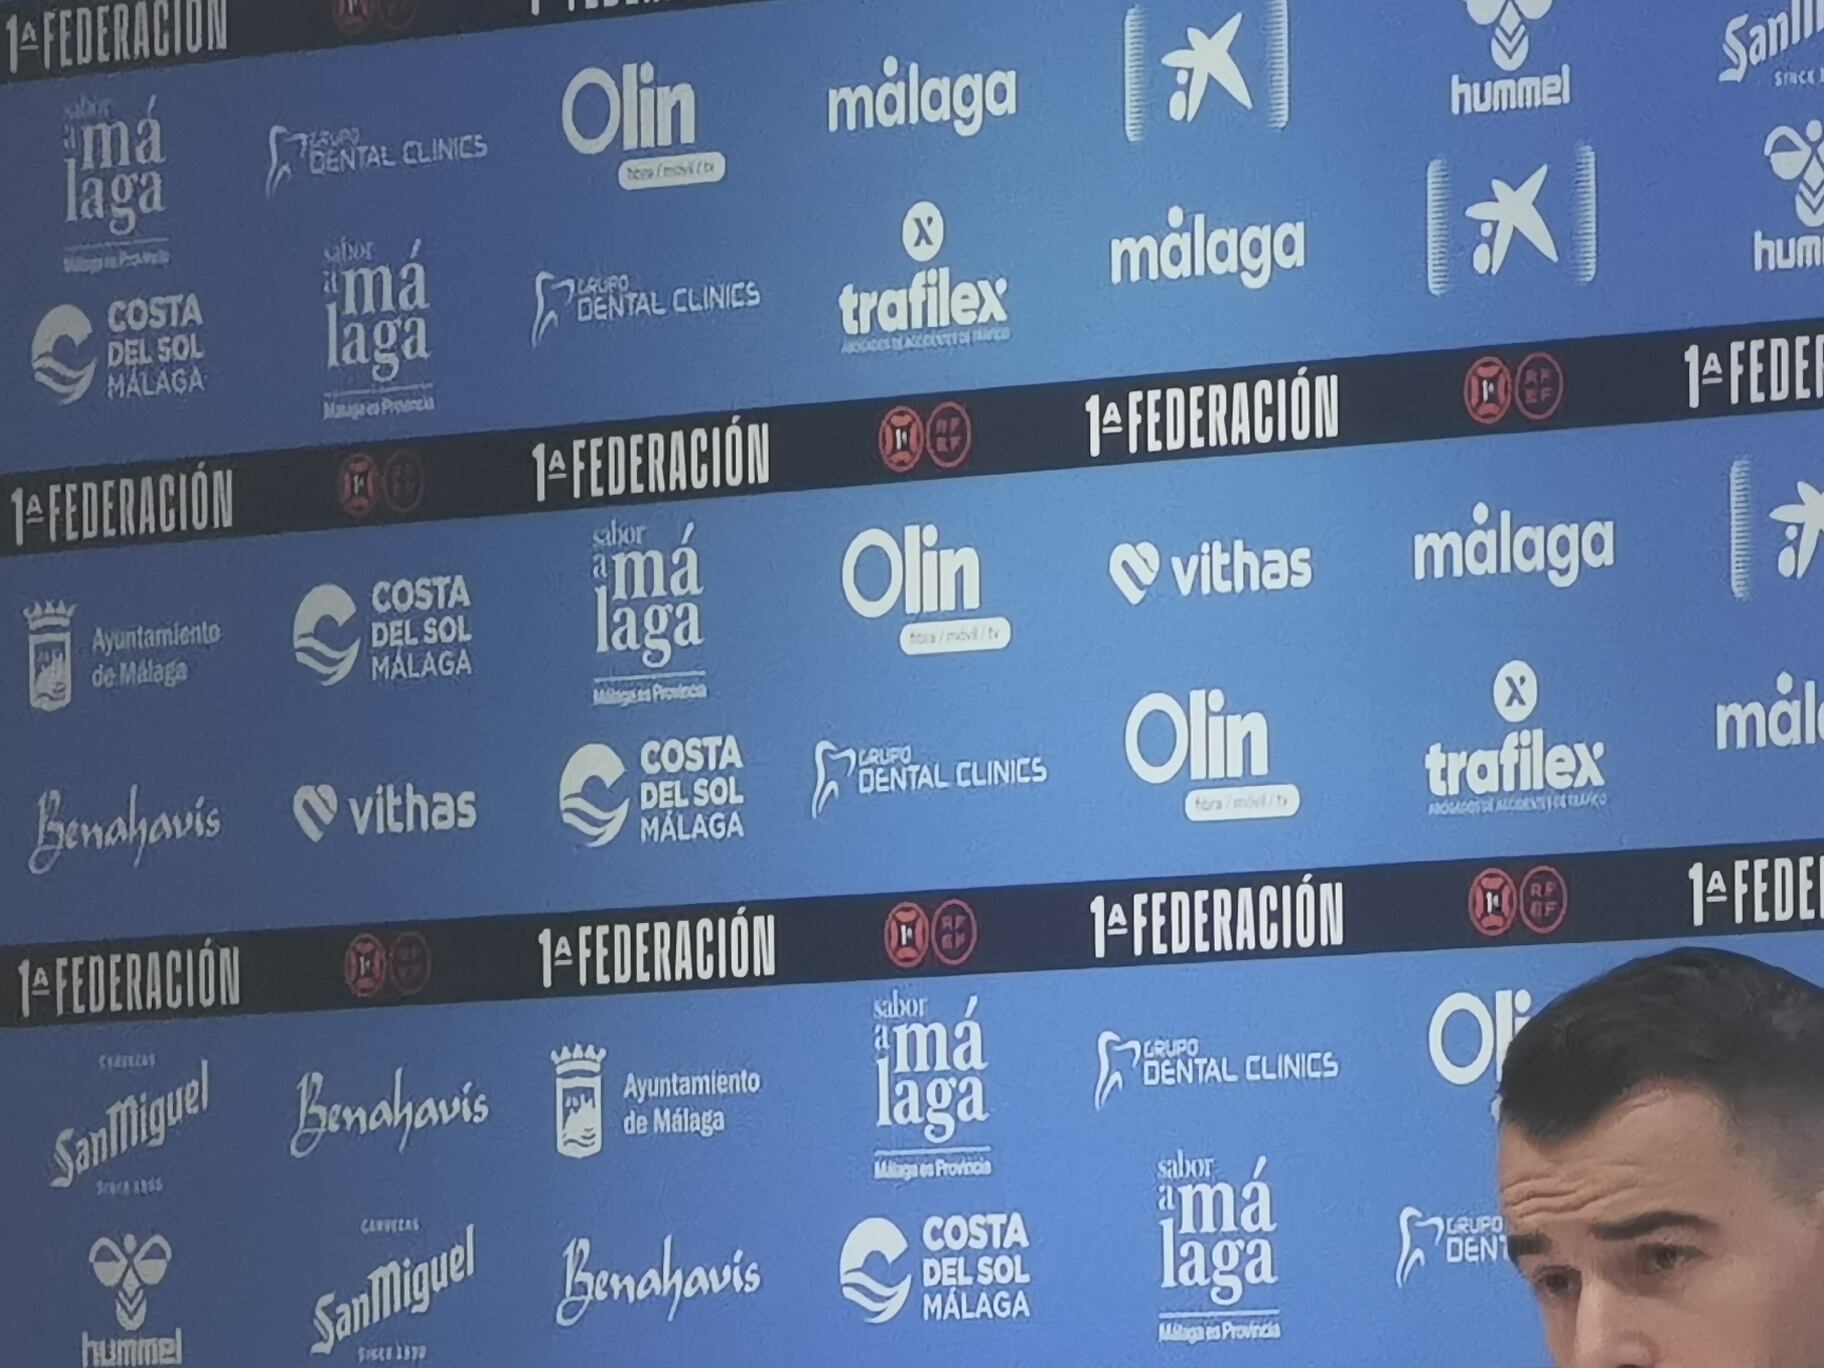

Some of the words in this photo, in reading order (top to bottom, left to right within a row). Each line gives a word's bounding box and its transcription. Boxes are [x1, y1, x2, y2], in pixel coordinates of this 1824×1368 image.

[562, 62, 695, 154] Olin
[1452, 64, 1570, 114] hummel
[342, 239, 429, 315] má
[839, 267, 1007, 336] trafilex
[108, 293, 203, 332] COSTA
[108, 338, 152, 370] DEL
[158, 333, 204, 362] SOL
[327, 306, 430, 382] laga
[108, 359, 204, 399] MÁLAGA
[1129, 367, 1338, 453] FEDERACIÓN
[573, 415, 769, 498] FEDERACIÓN
[50, 462, 232, 542] FEDERACIÓN
[612, 523, 703, 600] má
[843, 525, 979, 617] Olin
[1171, 540, 1311, 596] vithas
[372, 575, 470, 613] COSTA
[92, 621, 221, 656] Ayuntamiento
[372, 620, 417, 648] DEL
[424, 615, 472, 643] SOL
[595, 581, 704, 667] laga
[92, 664, 116, 688] de
[120, 658, 188, 687] Málaga
[372, 643, 471, 680] MÁLAGA
[641, 735, 743, 774] COSTA
[1126, 689, 1268, 783] Olin
[859, 764, 950, 793] DENTAL
[957, 757, 1047, 787] CLINICS
[1425, 729, 1604, 796] trafilex
[349, 783, 476, 834] vithas
[641, 781, 687, 809] DEL
[694, 776, 743, 806] SOL
[641, 810, 744, 842] MÁLAGA
[1134, 874, 1343, 955] FEDERACIÓN
[579, 907, 775, 985] FEDERACIÓN
[56, 938, 239, 1015] FEDERACIÓN
[874, 990, 927, 1019] sabor
[893, 996, 987, 1072] má
[624, 1070, 760, 1103] Ayuntamiento
[1144, 1057, 1238, 1085] DENTAL
[1246, 1052, 1338, 1080] CLINICS
[291, 1068, 488, 1157] Benahavís
[877, 1048, 988, 1143] laga
[624, 1110, 648, 1134] de
[654, 1108, 724, 1136] Málaga
[1158, 1150, 1214, 1179] sabor
[1178, 1156, 1276, 1234] má
[923, 1213, 1029, 1251] COSTA
[557, 1235, 760, 1325] Benahavís
[924, 1257, 971, 1286] DEL
[977, 1255, 1030, 1285] SOL
[1160, 1213, 1277, 1305] laga
[924, 1287, 1030, 1320] MÁLAGA
[82, 1328, 182, 1368] hummel
